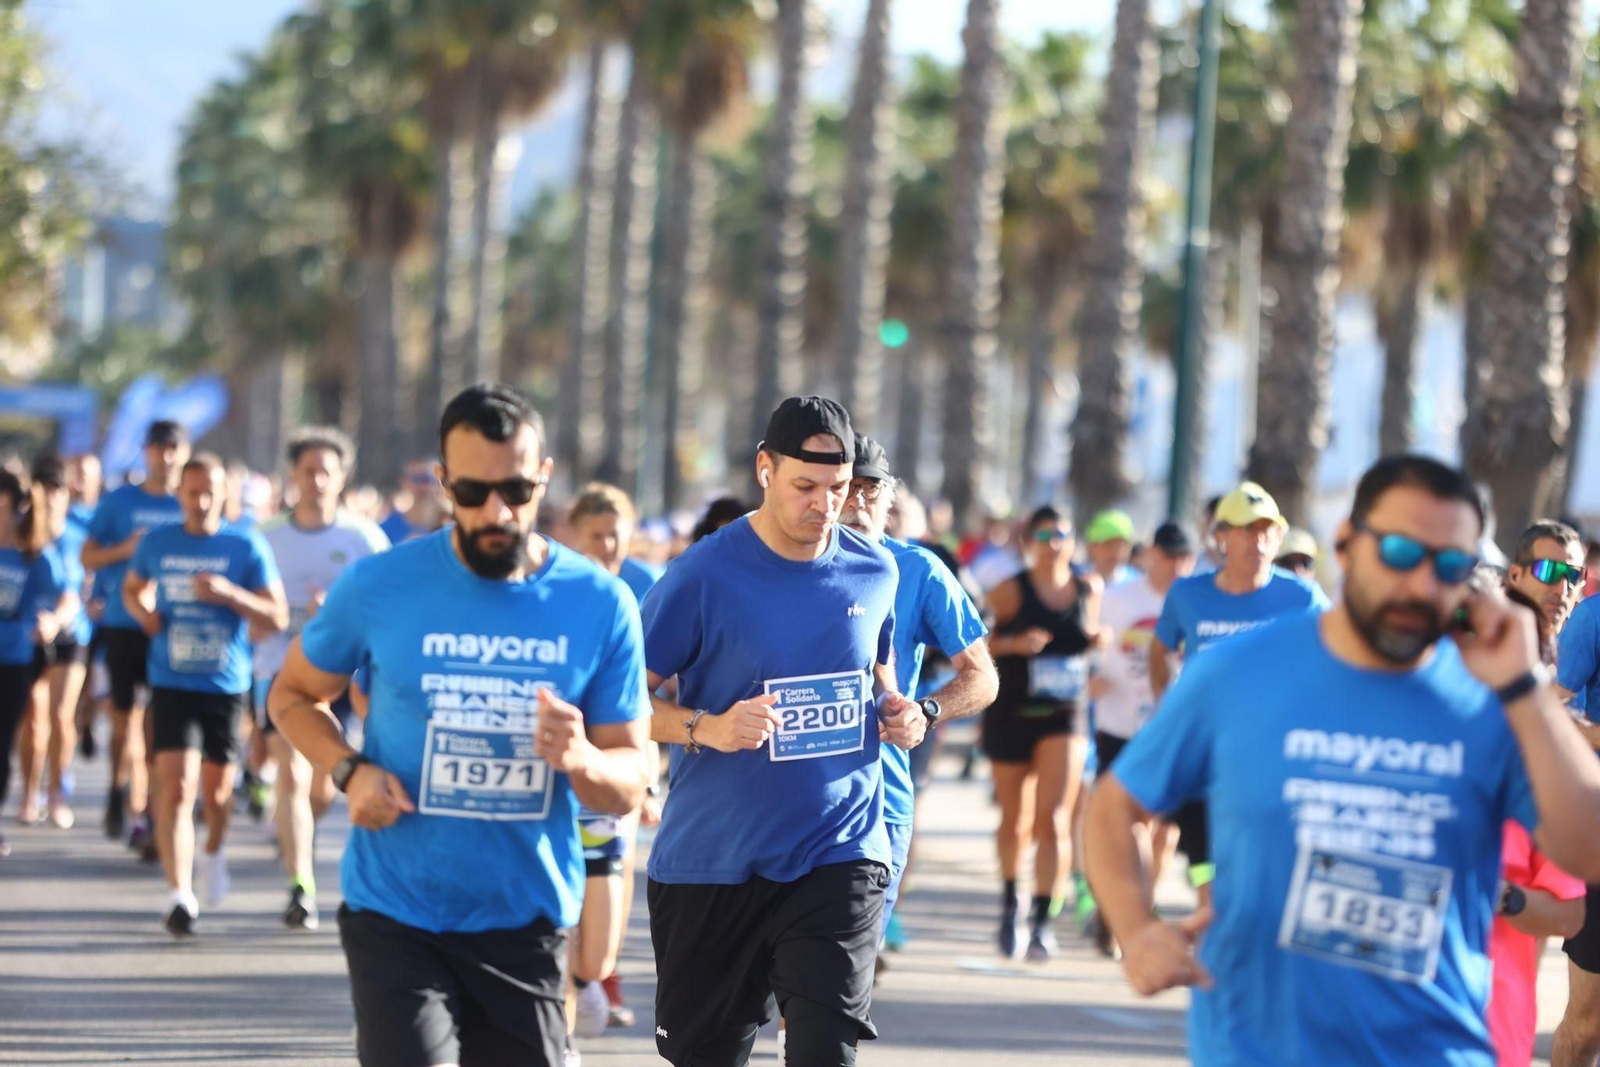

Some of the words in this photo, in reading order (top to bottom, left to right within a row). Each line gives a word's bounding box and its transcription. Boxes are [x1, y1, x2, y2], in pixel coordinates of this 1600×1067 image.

[422, 633, 568, 665] mayoral
[785, 688, 815, 696] Carrera
[785, 694, 821, 704] Solidaria
[782, 703, 855, 731] 2200
[778, 734, 797, 743] 10KM
[1283, 729, 1464, 777] mayoral
[444, 761, 534, 787] 1971
[1316, 892, 1424, 940] 1853
